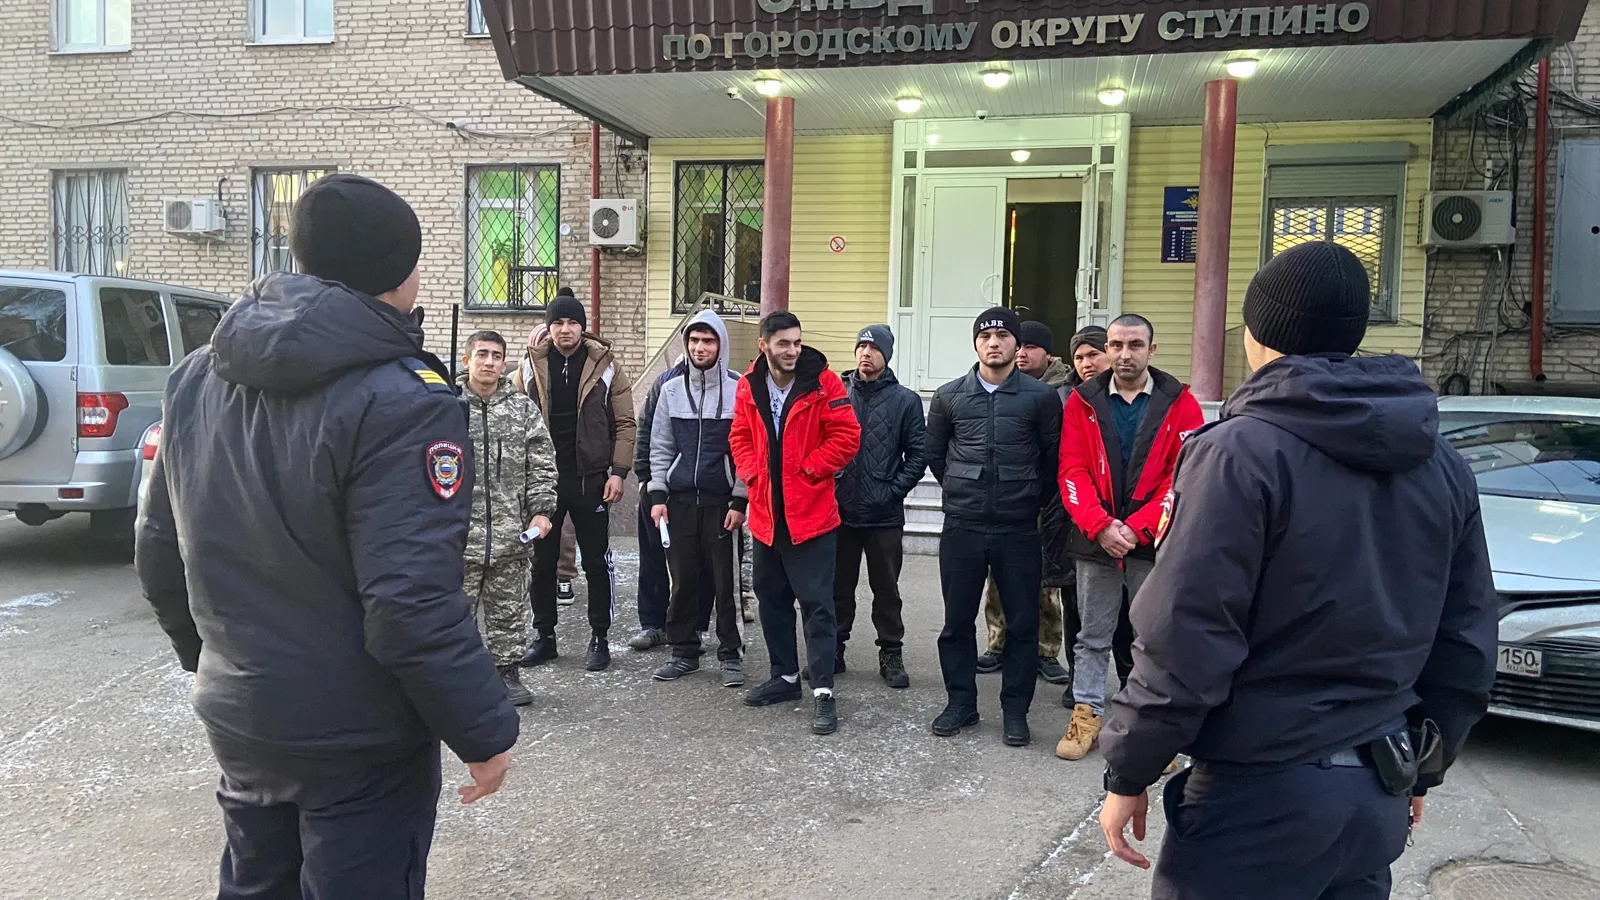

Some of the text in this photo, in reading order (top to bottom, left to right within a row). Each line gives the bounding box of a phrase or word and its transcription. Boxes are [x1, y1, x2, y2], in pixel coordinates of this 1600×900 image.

[662, 2, 1370, 61] ПО ГОРОДСКОМУ ОКРУГУ СТУПИНО
[980, 319, 1004, 330] SABR
[1500, 648, 1536, 667] 150
[1506, 664, 1525, 673] RUS
